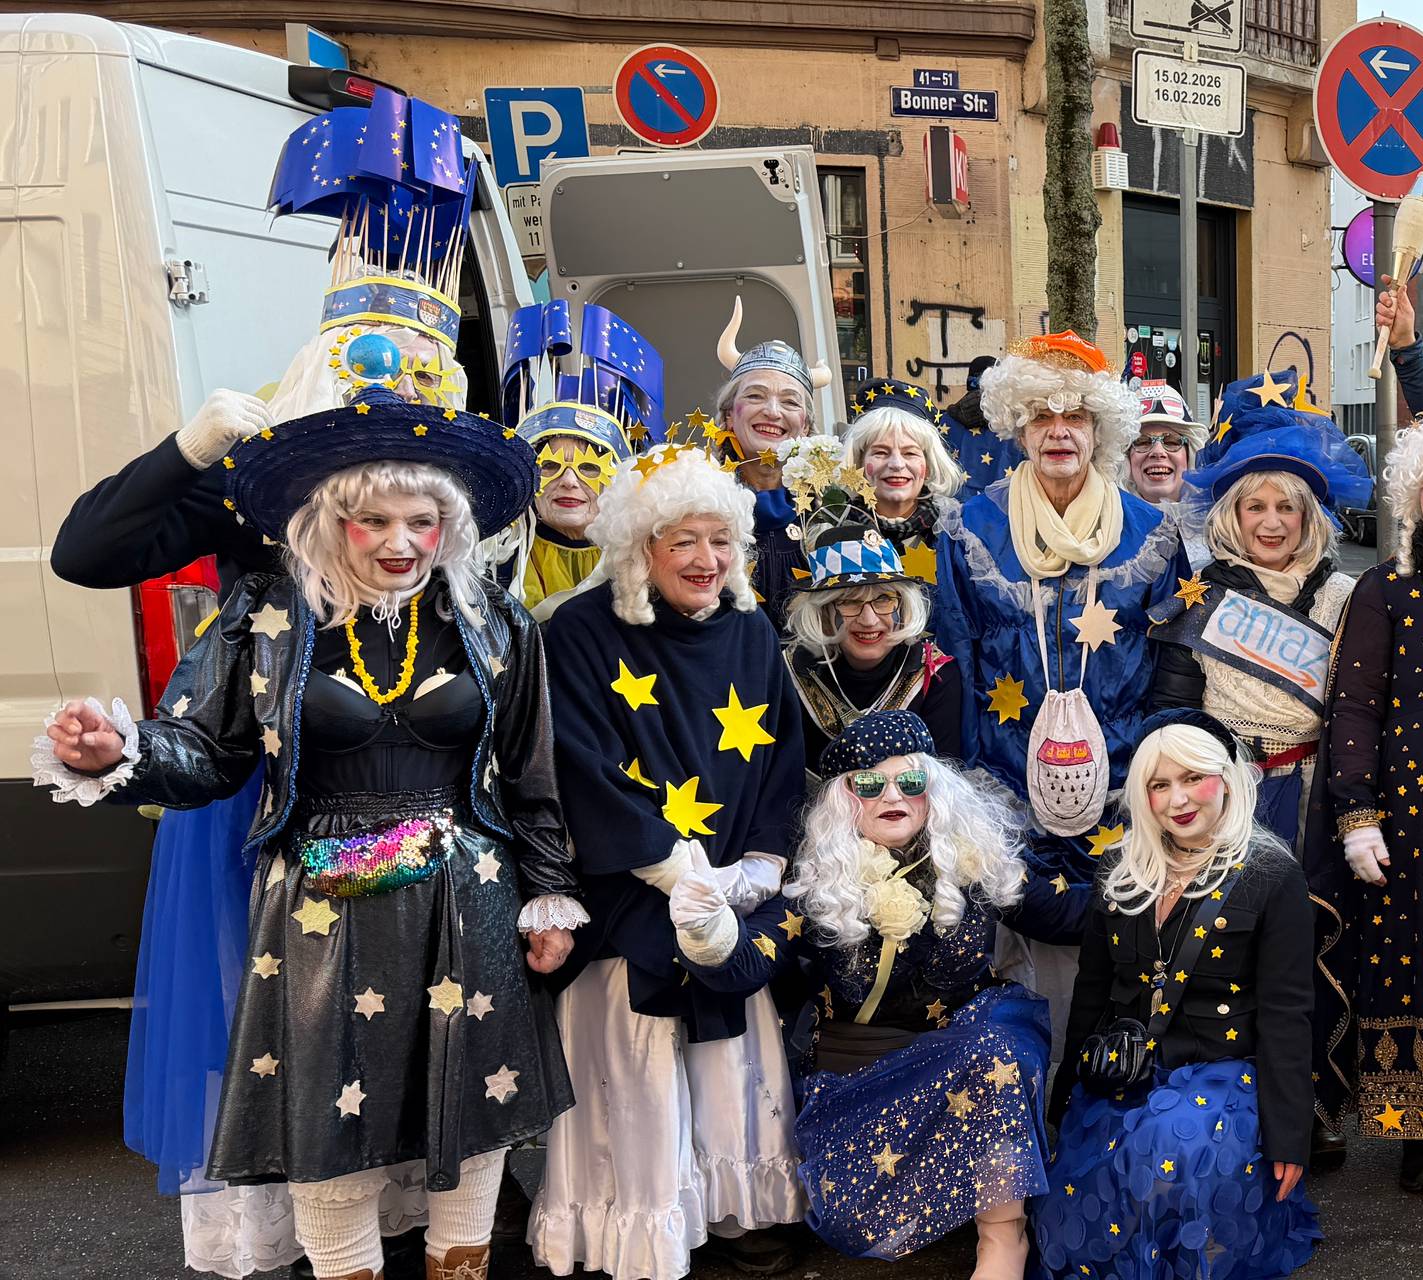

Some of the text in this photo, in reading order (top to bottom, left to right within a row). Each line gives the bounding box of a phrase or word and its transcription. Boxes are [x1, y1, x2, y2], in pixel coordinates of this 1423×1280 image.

[1154, 69, 1221, 89] 15.02.2026
[900, 90, 988, 112] Bonner Str.
[1154, 88, 1221, 107] 16.02.2026
[509, 100, 562, 176] P
[512, 195, 525, 209] mit
[528, 231, 540, 247] 11
